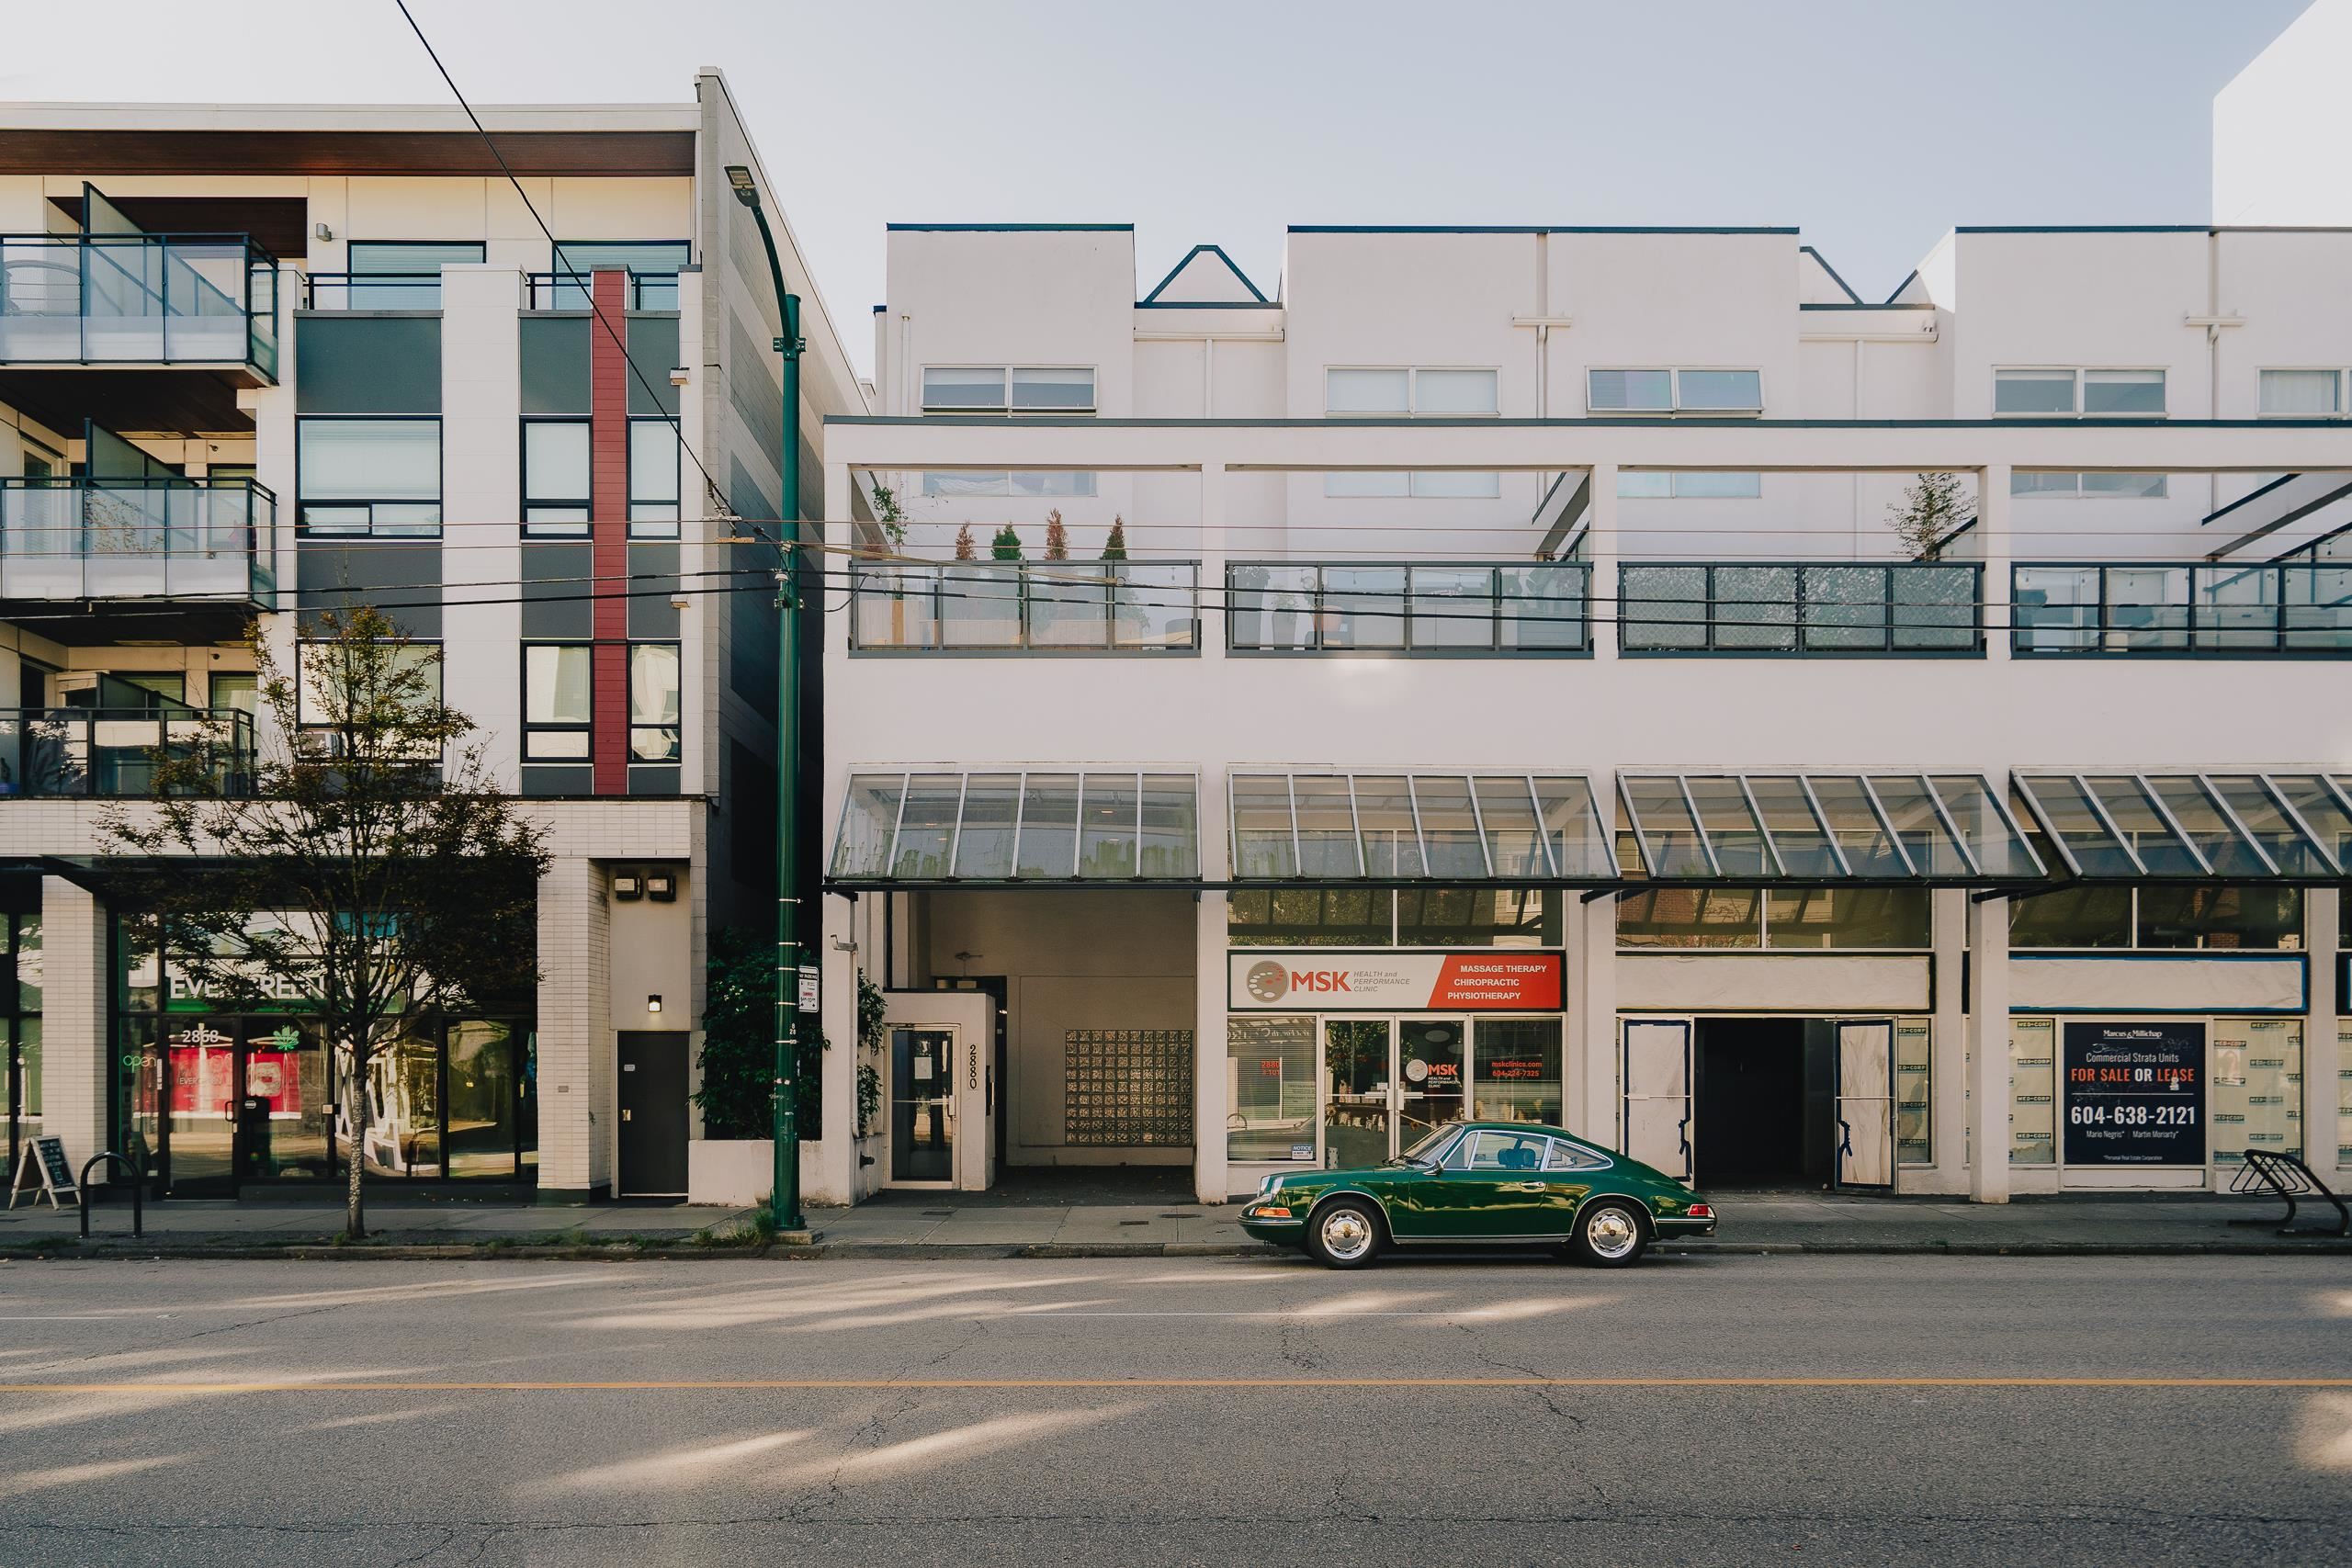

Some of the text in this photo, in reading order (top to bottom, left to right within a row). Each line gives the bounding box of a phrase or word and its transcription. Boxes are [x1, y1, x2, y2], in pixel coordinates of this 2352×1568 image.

[1460, 964, 1547, 973] MASSAGE THERAPY
[170, 972, 325, 999] EVEREEN
[1291, 971, 1351, 992] MSK
[1453, 978, 1520, 987] CHIROPRACTIC
[1447, 992, 1521, 1000] PHYSIOTHERAPY
[183, 1030, 219, 1043] 2868
[2132, 1030, 2163, 1039] Millichap
[123, 1055, 156, 1073] open
[2086, 1053, 2179, 1063] Commercial Strata Units
[969, 1043, 978, 1089] 2880
[1428, 1064, 1458, 1075] MSK
[2071, 1068, 2195, 1082] FOR SALE OR LEASE
[2071, 1106, 2195, 1124] 604-638-2121
